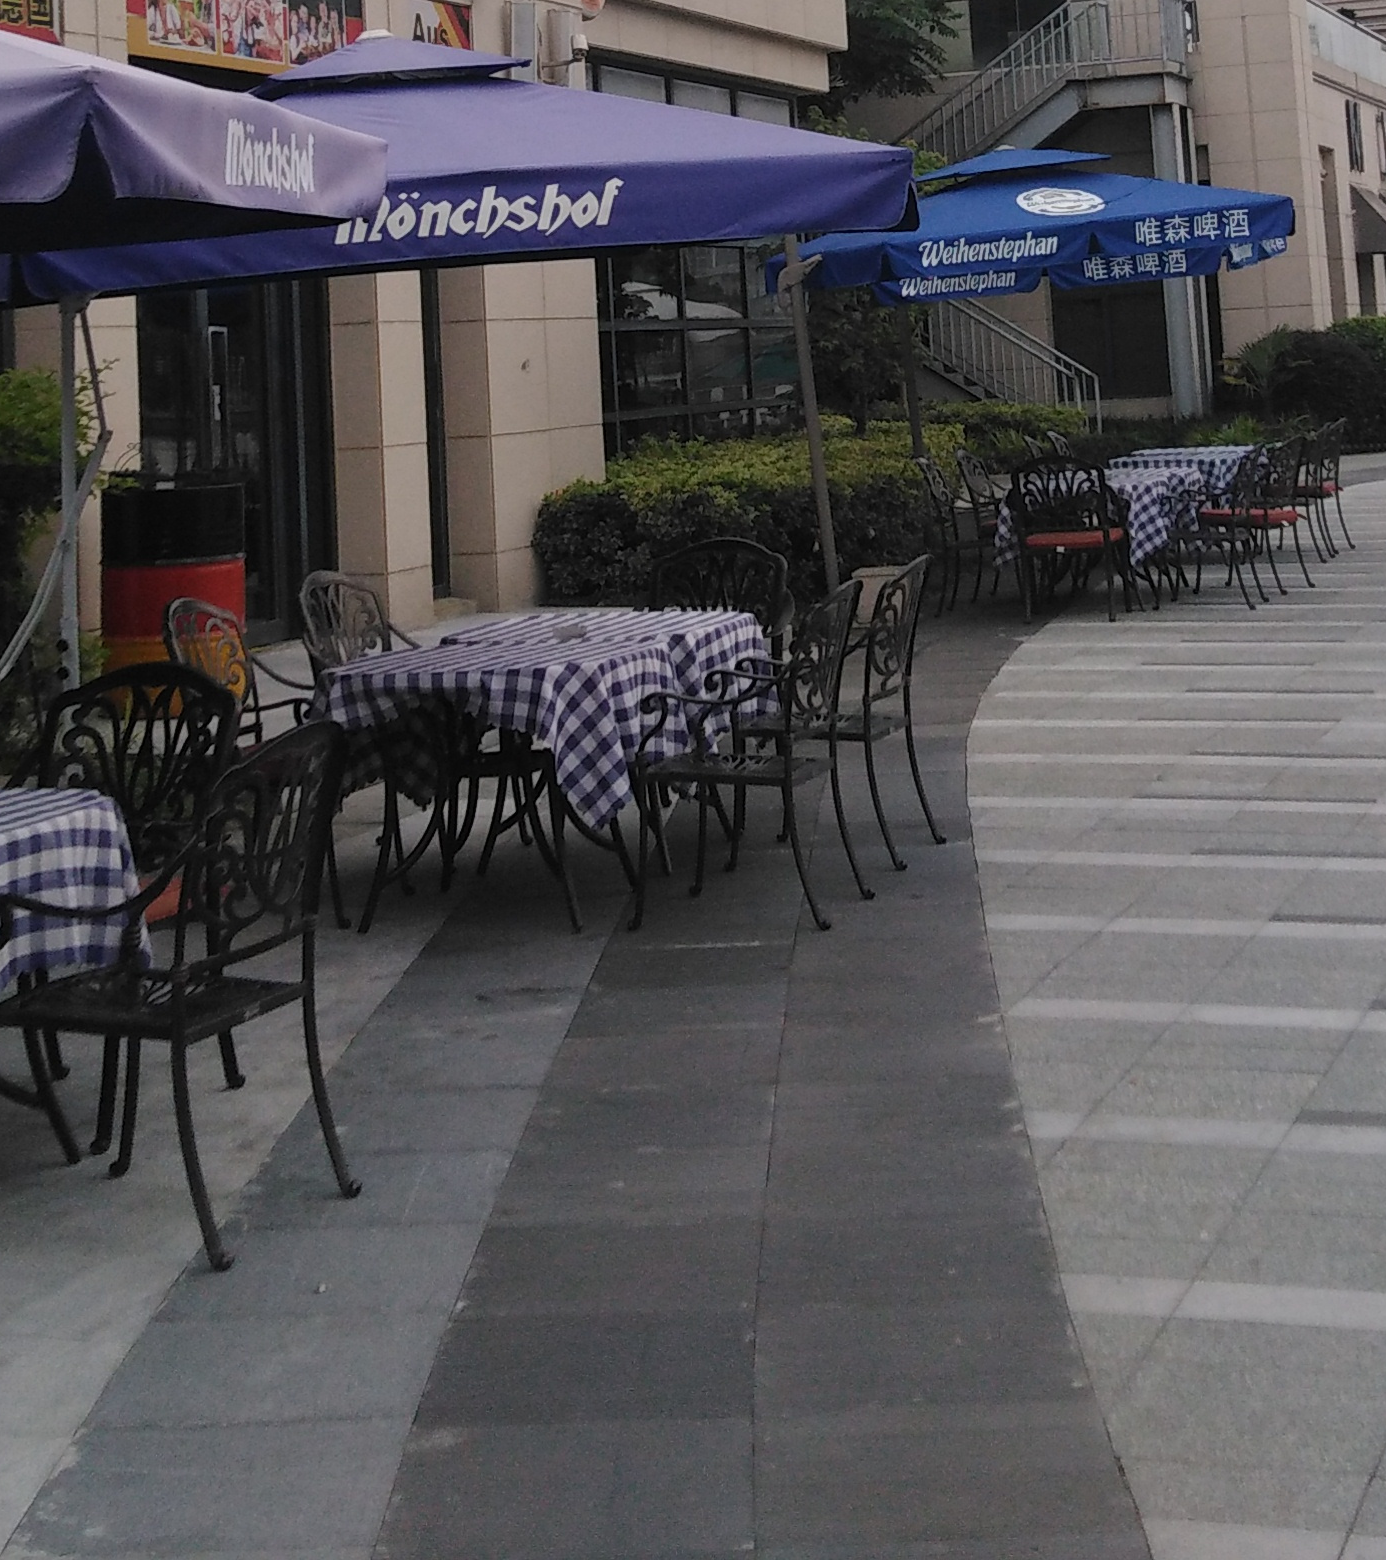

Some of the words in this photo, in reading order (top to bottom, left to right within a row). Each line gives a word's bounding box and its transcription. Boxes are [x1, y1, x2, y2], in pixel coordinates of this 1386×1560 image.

[1134, 208, 1251, 248] 唯森啤酒
[918, 230, 1059, 268] Weihenstephan
[1082, 248, 1188, 281] 唯森啤酒
[898, 269, 1016, 298] Weihenstephan
